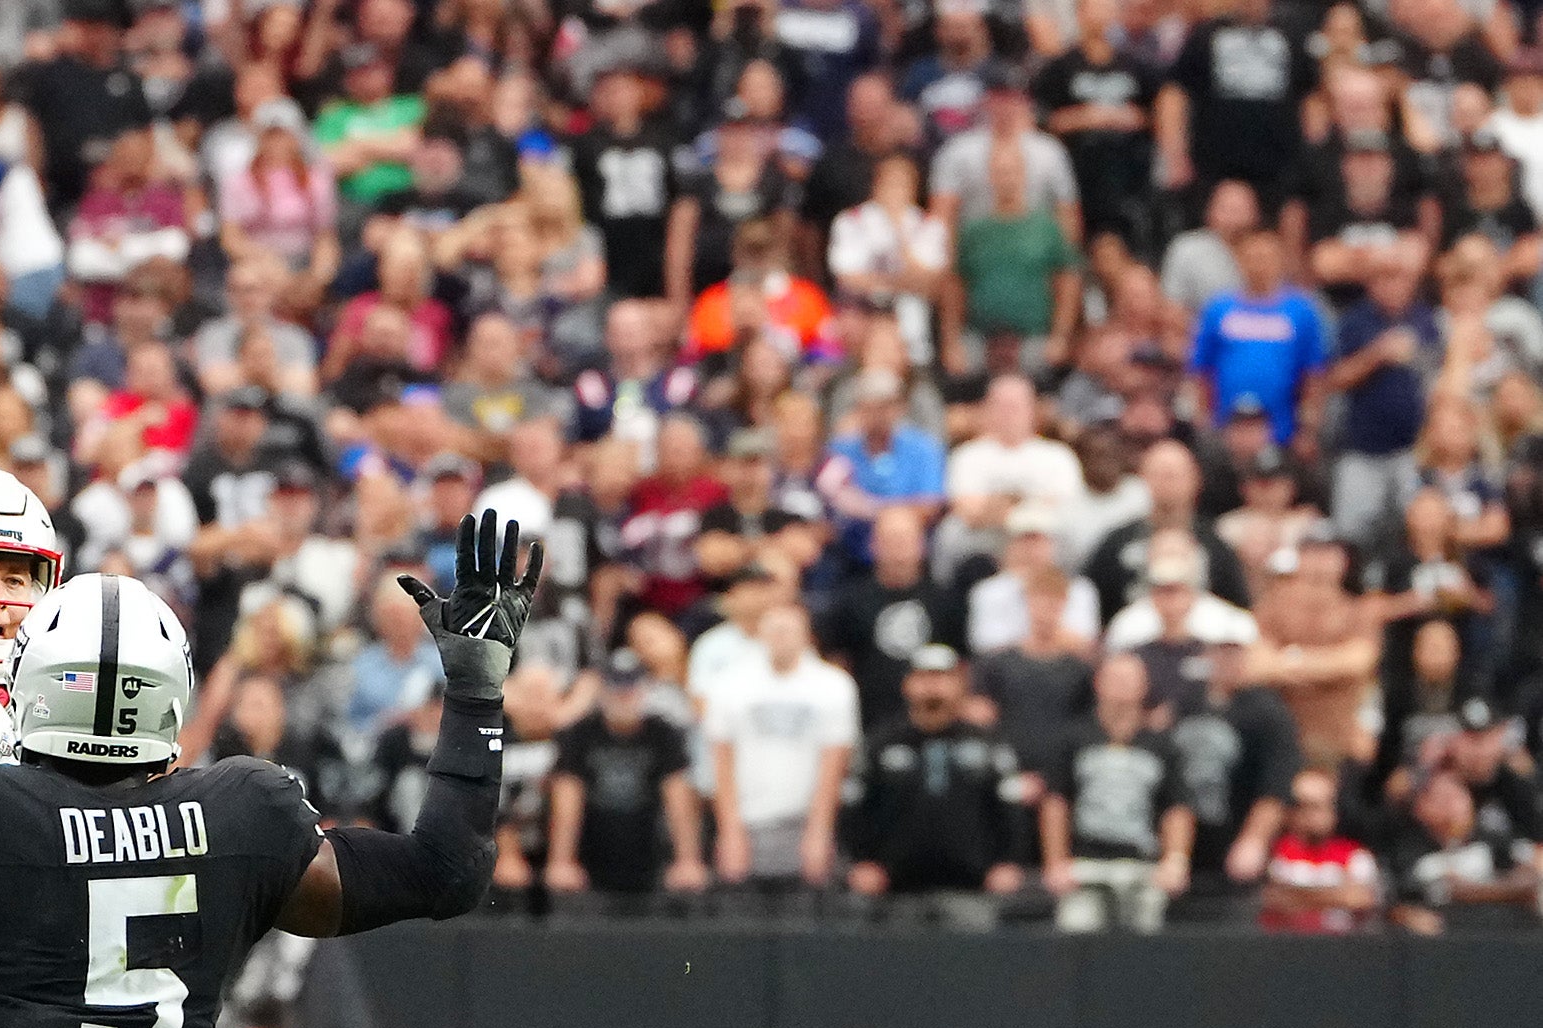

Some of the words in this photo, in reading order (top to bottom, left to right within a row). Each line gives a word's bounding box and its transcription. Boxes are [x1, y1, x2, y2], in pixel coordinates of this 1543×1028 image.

[124, 680, 139, 691] AL
[117, 708, 139, 735] 5
[67, 741, 139, 758] RAIDERS
[60, 801, 208, 864] DEABLO
